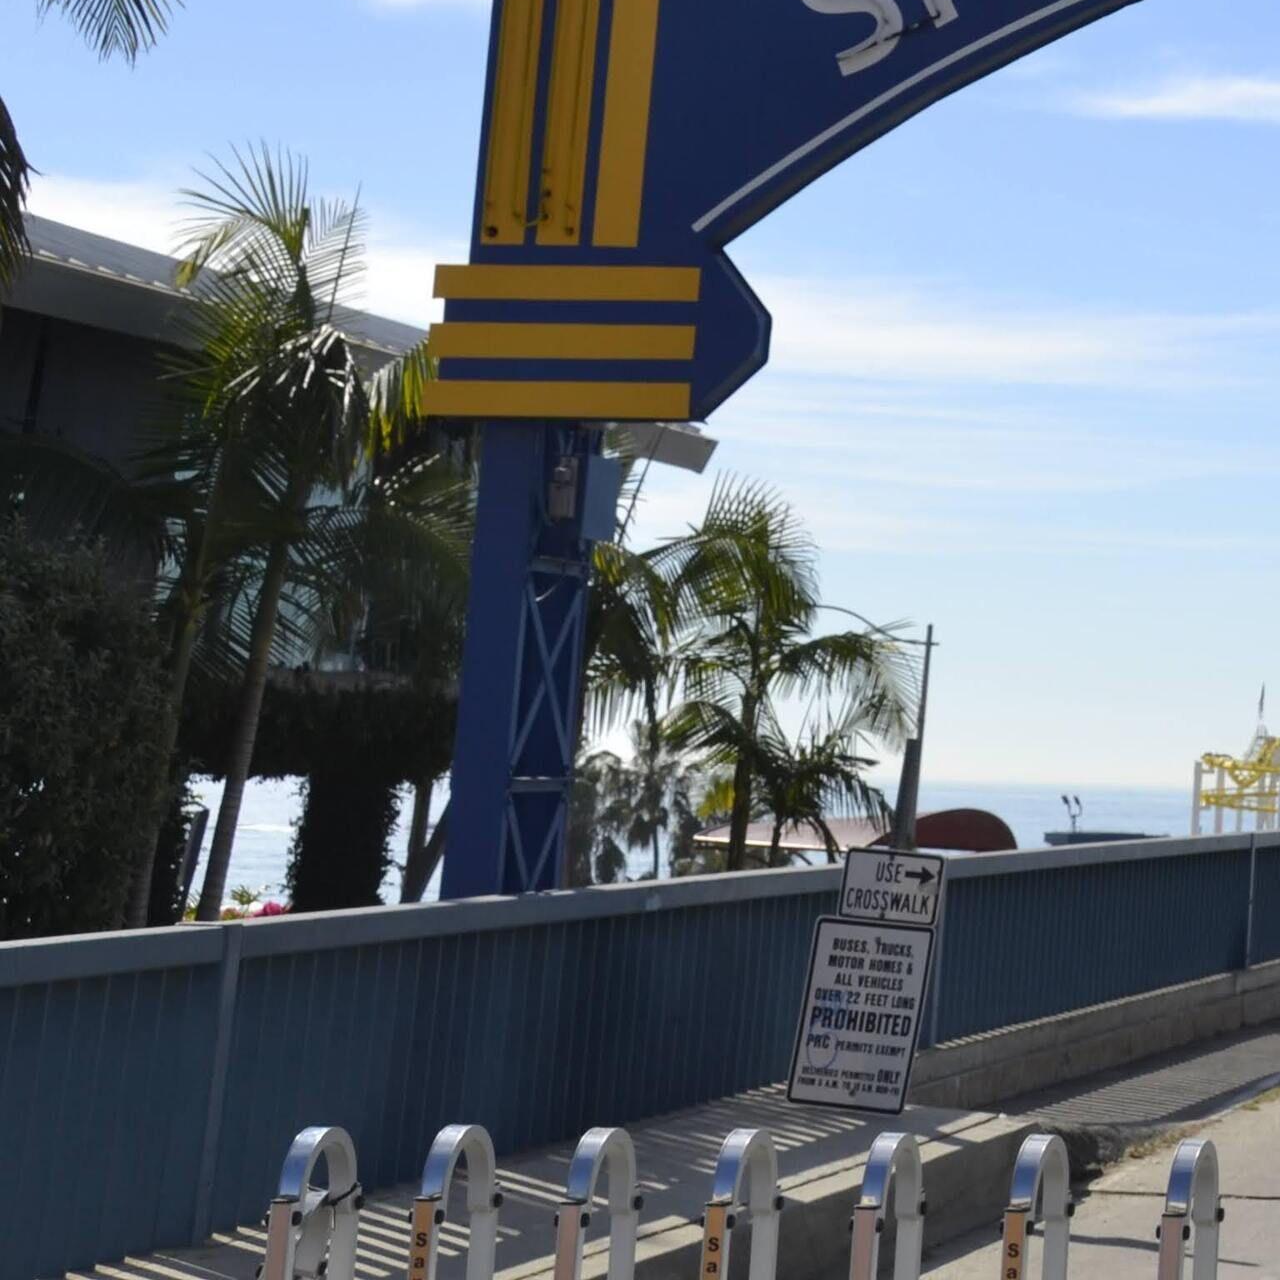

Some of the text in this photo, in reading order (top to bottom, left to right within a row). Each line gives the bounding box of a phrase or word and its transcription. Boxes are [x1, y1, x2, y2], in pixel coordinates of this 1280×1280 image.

[876, 861, 904, 884] USE
[846, 887, 930, 915] CROSSWALK
[828, 954, 865, 970] MOTOR
[869, 959, 903, 974] HOMES
[834, 972, 904, 992] ALL VEHICLES
[814, 987, 915, 1010] OVER 22 FEET LONG
[809, 1006, 912, 1037] PROHIBITED
[806, 1033, 906, 1058] PRC PERMITS EXEMPT
